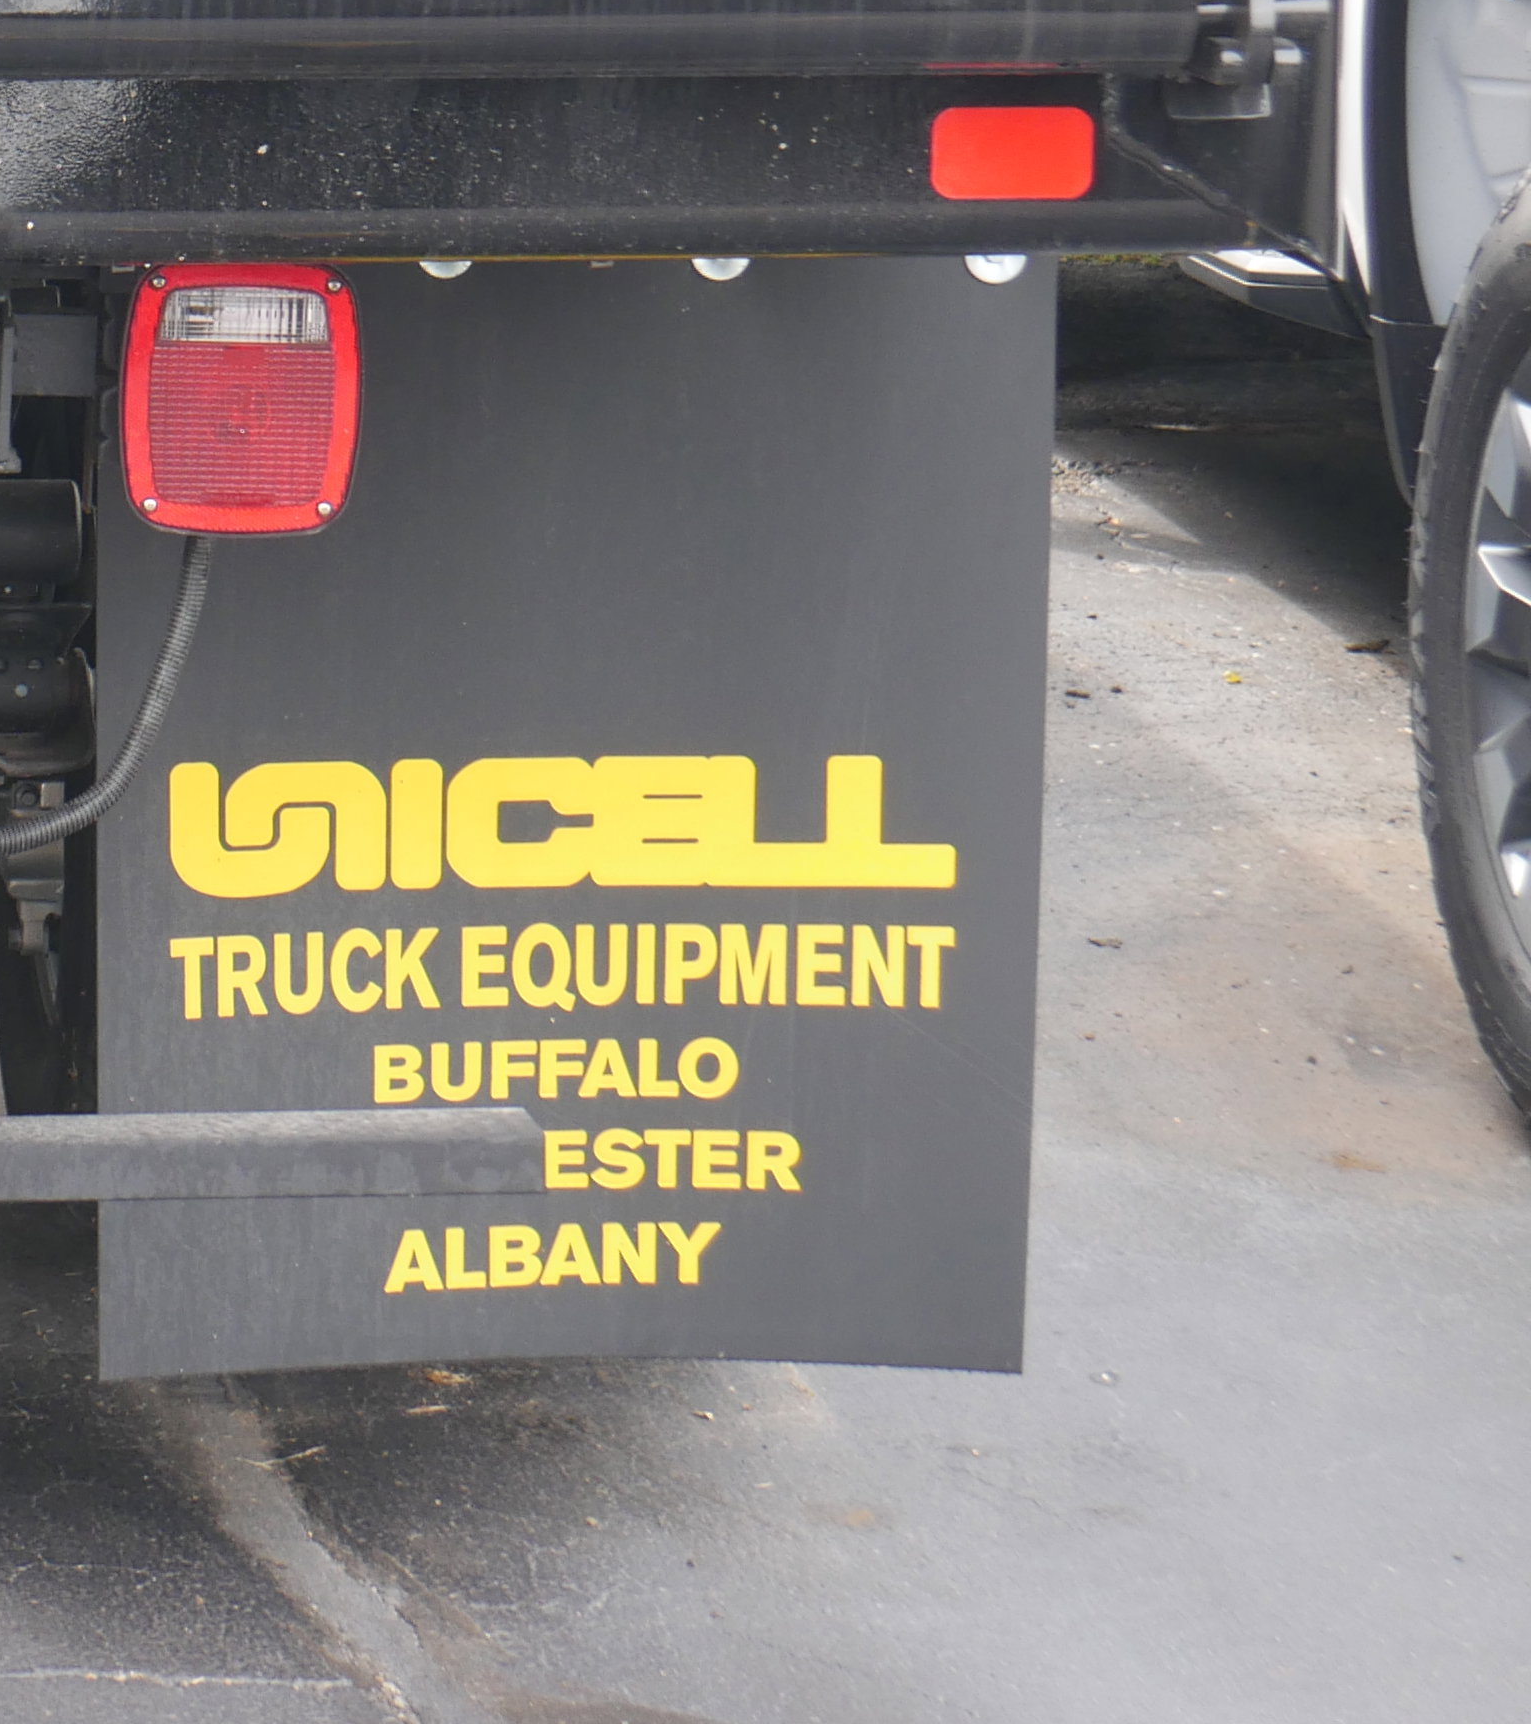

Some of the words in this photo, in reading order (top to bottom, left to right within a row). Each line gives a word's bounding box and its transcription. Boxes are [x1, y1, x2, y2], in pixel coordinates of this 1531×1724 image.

[169, 755, 958, 898] UNICELL
[170, 928, 441, 1020] TRUCK
[461, 924, 956, 1012] EQUIPMENT
[373, 1038, 740, 1104] BUFFALO
[544, 1127, 802, 1192] ESTER
[383, 1223, 721, 1293] ALBANY
